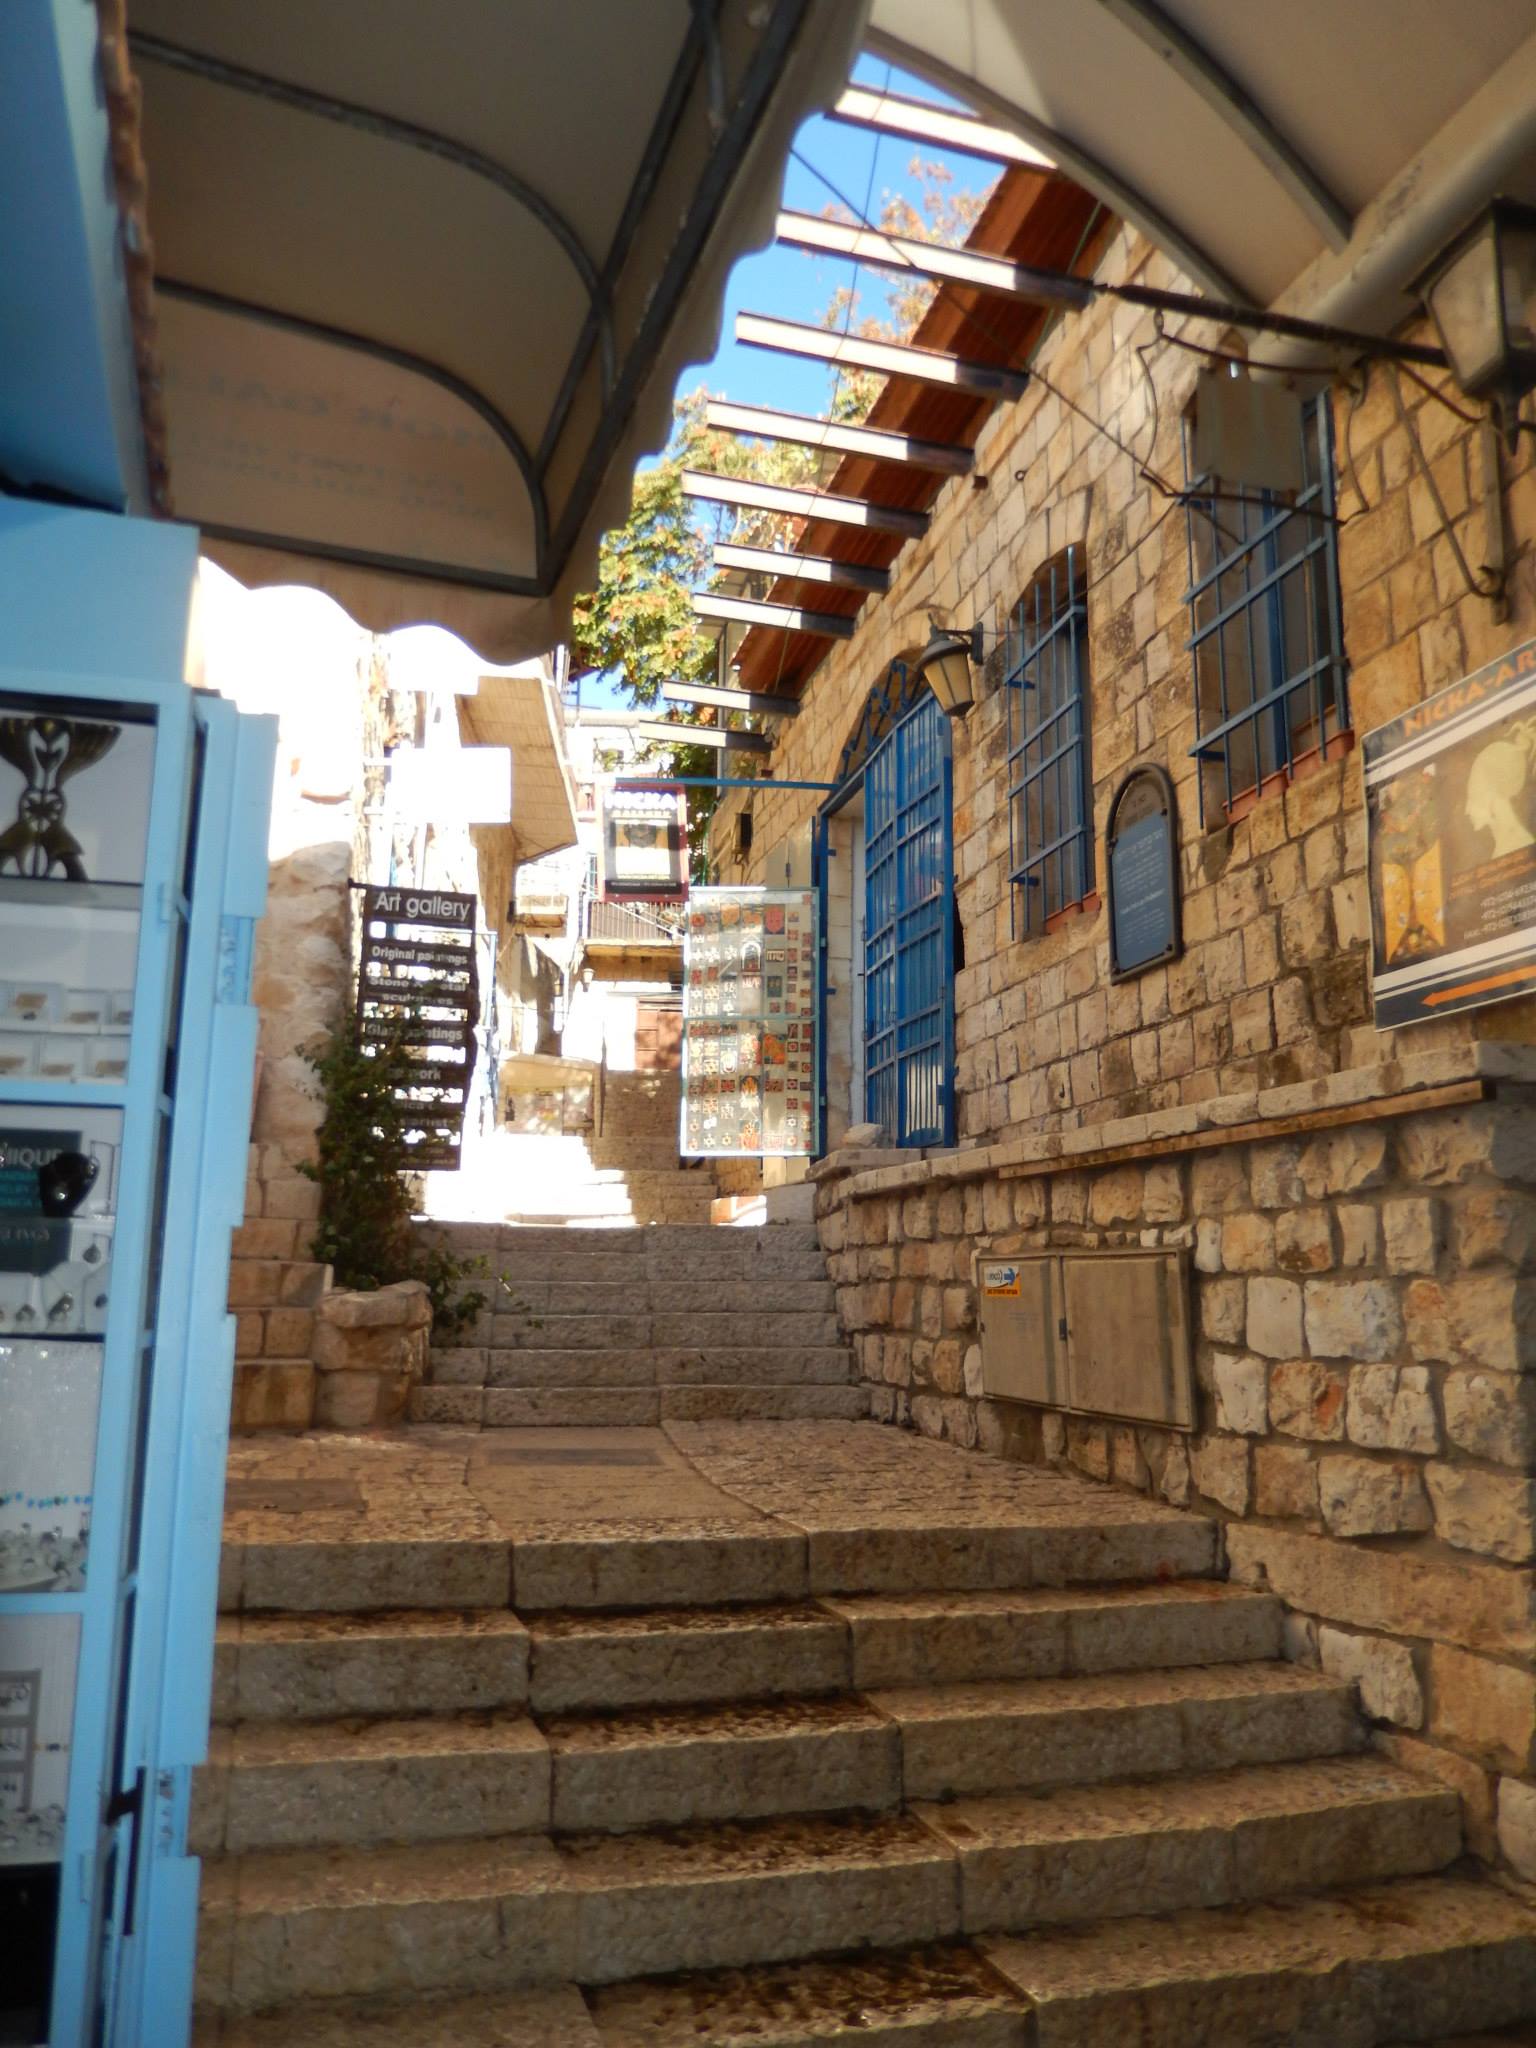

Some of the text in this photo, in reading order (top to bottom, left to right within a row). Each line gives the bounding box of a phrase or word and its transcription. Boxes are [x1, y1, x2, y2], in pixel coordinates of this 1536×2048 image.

[1404, 649, 1536, 737] NICKA-AR
[375, 892, 470, 921] Art gallery
[372, 946, 415, 960] Original
